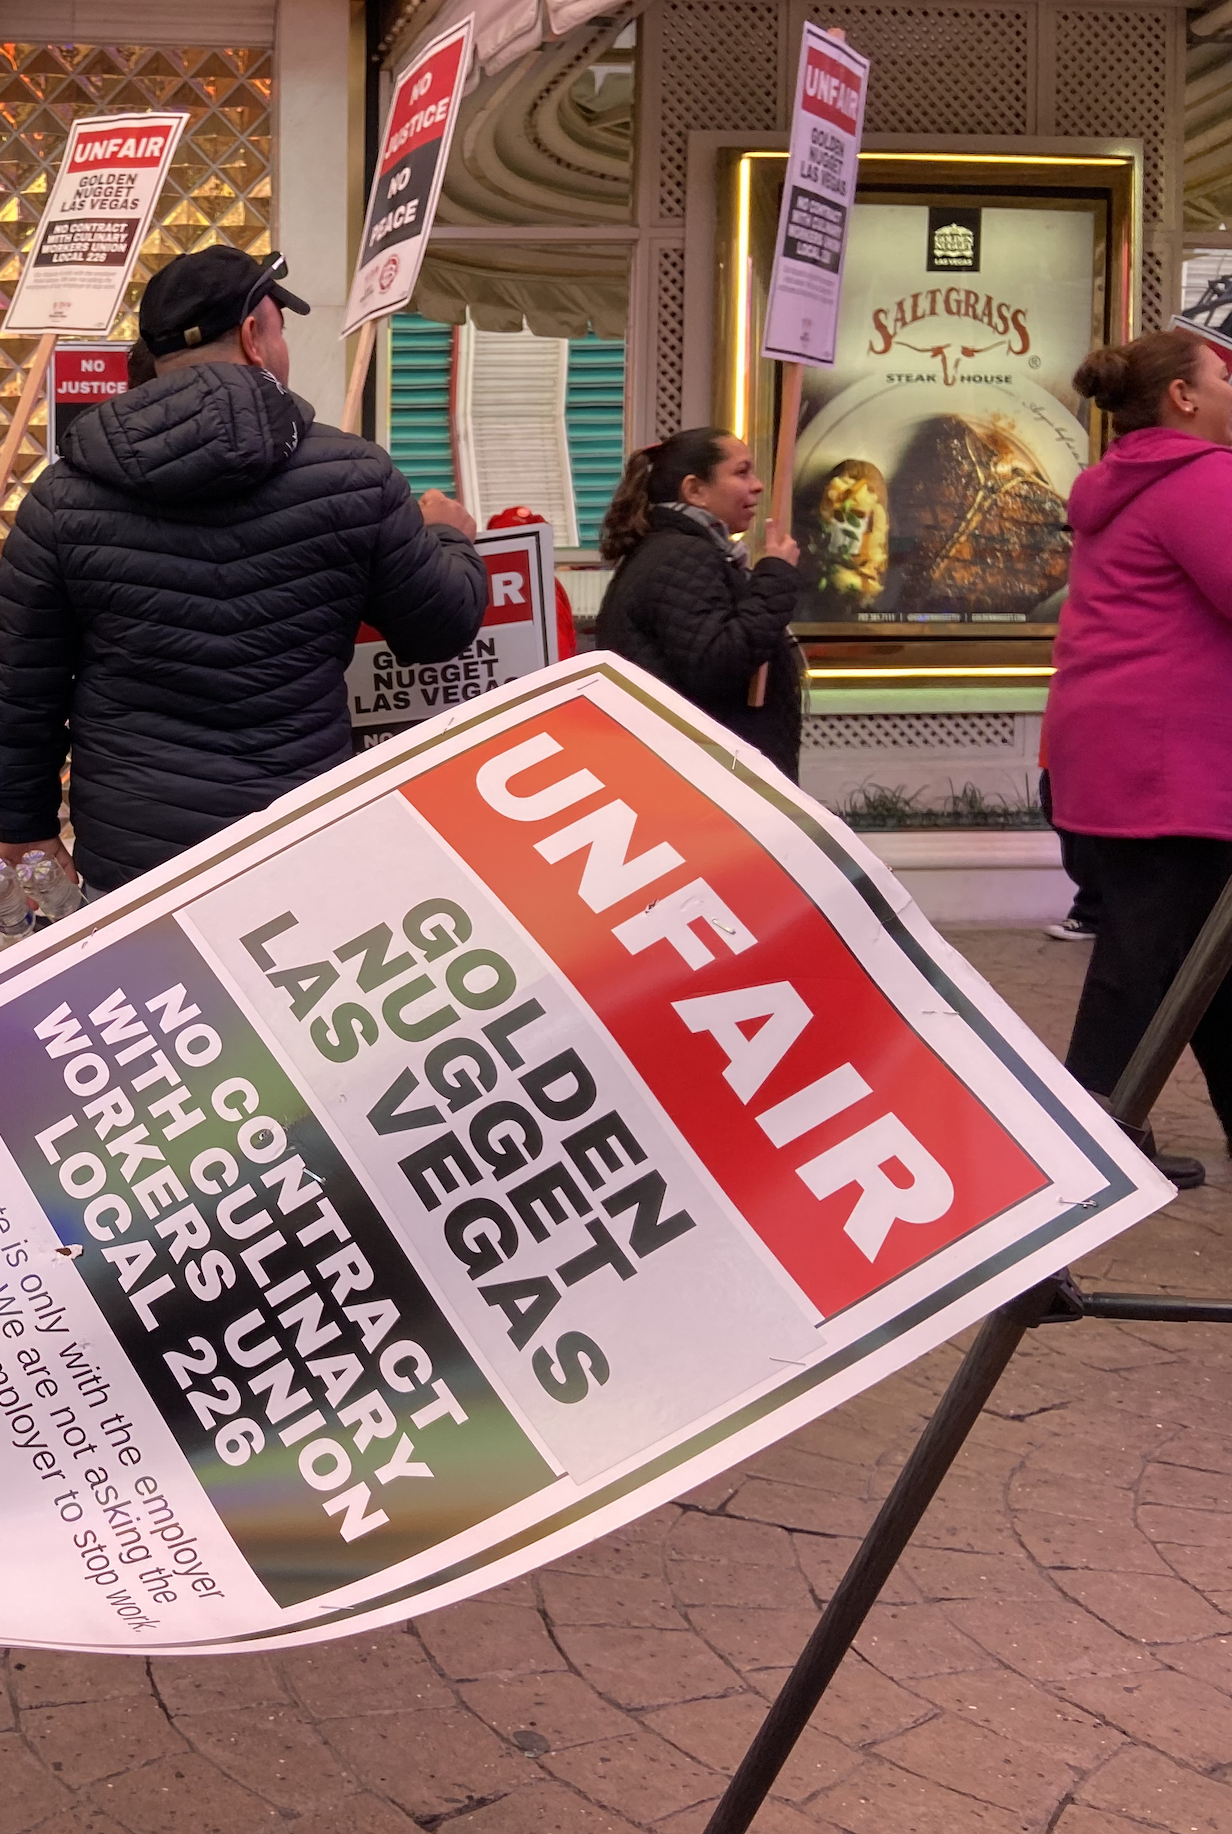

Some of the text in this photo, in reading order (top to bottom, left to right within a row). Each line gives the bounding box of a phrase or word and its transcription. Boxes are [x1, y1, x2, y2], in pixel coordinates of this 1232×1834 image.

[408, 71, 433, 106] NO
[805, 64, 859, 121] UNFAIR
[73, 136, 166, 164] UNFAIR
[384, 96, 451, 160] JUSTICE
[73, 186, 135, 200] NUGGET
[79, 173, 139, 188] GOLDEN
[387, 166, 412, 200] NO
[800, 160, 819, 183] LAS
[60, 198, 140, 213] LAS VEGAS
[70, 223, 128, 233] CONTRACT
[368, 198, 420, 248] PEACE
[867, 286, 1031, 356] SALTGRASS
[57, 381, 128, 394] JUSTICE
[80, 359, 106, 372] NO
[886, 373, 1013, 385] STEAK HOUSE
[354, 677, 518, 715] LAS VEGA
[373, 658, 499, 691] NUGGET
[476, 731, 956, 1263] UNFAIR
[335, 919, 637, 1286] NUGGET
[401, 896, 697, 1259] GOLDEN
[238, 910, 610, 1404] LAS VEGAS
[146, 983, 469, 1430] NO CONTRACT
[88, 987, 435, 1487] WITH CULINARY
[33, 1002, 392, 1544] WORKERS UNION
[33, 1114, 266, 1467] LOCAL 226
[0, 1239, 28, 1268] is
[20, 1273, 69, 1333] only
[59, 1341, 110, 1408] with
[100, 1413, 142, 1467] the
[134, 1475, 225, 1599] employer
[16, 1347, 59, 1399] are
[49, 1405, 98, 1460] not
[84, 1466, 152, 1565] asking
[138, 1566, 178, 1604] the
[53, 1489, 84, 1523] to
[73, 1529, 120, 1586] stop
[105, 1588, 161, 1633] work.
